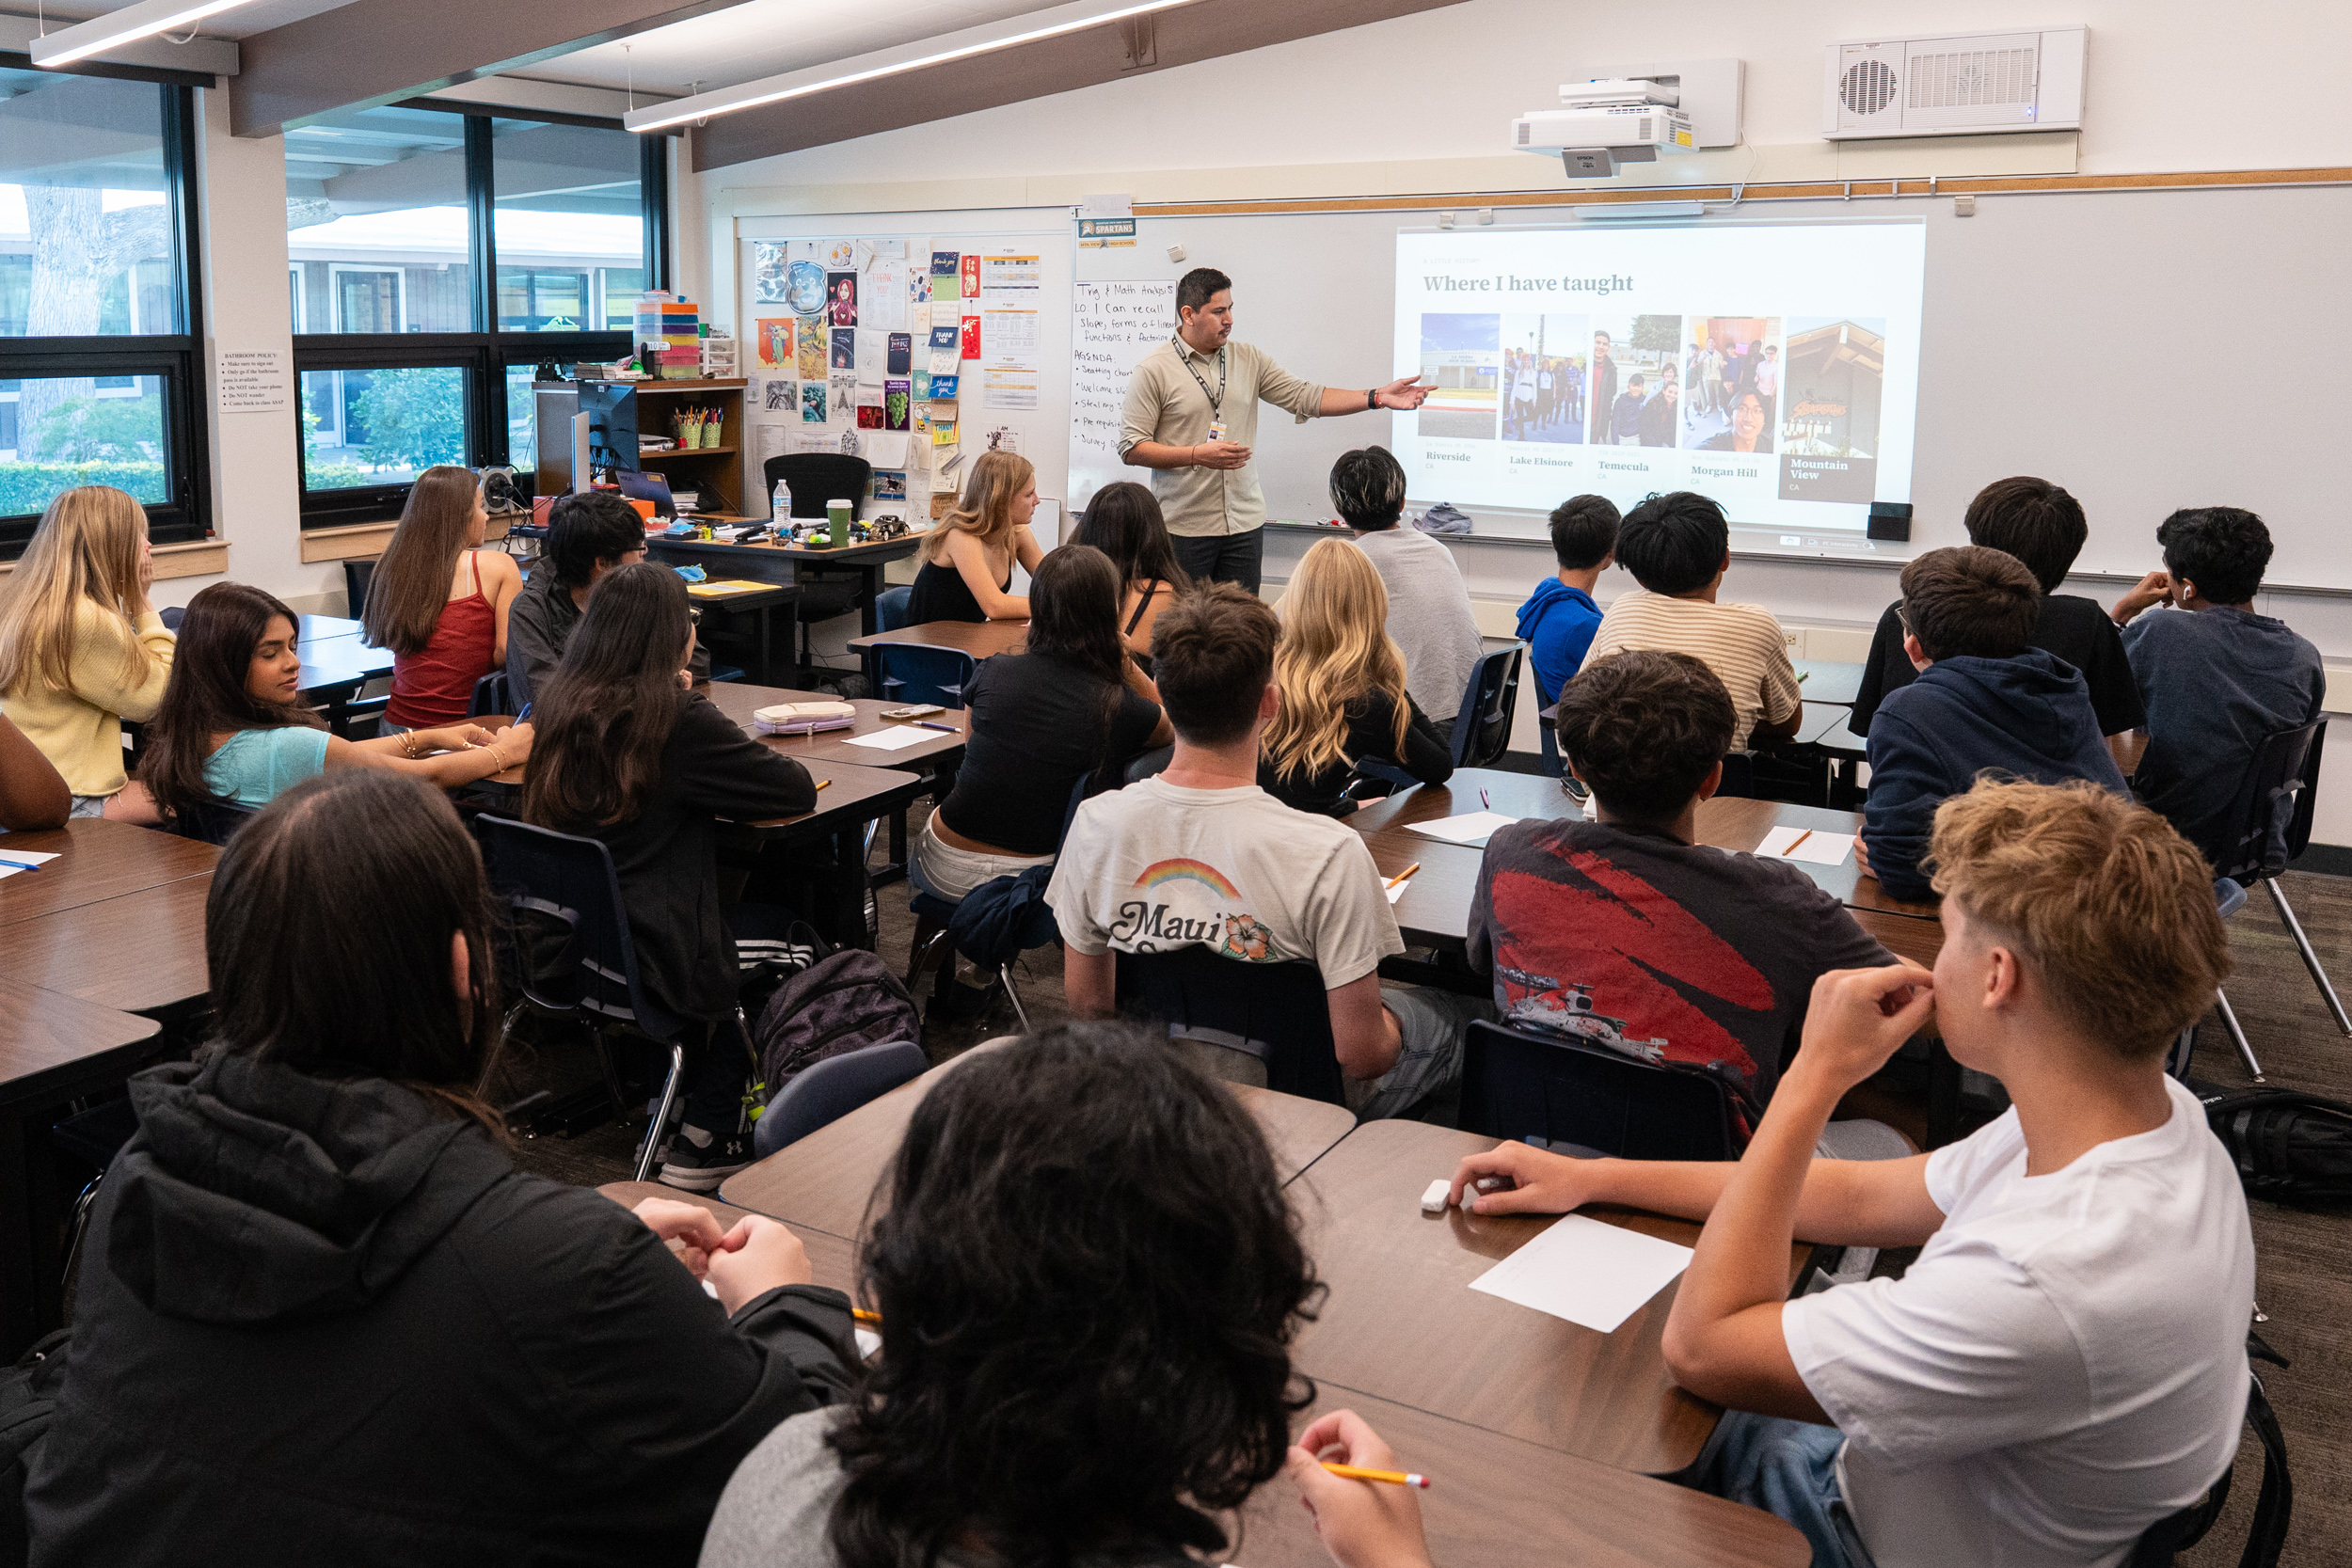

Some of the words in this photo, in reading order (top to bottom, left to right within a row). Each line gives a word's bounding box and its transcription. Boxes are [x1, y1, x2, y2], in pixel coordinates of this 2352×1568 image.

[1095, 224, 1134, 234] SPARTANS
[1423, 275, 1490, 292] Where
[1495, 276, 1503, 291] I
[1508, 275, 1557, 292] have
[1562, 274, 1634, 296] taught
[1077, 284, 1100, 300] Trig
[1114, 284, 1136, 295] Math
[1142, 285, 1173, 296] Analysis
[1133, 304, 1164, 314] recall
[1111, 319, 1136, 329] forms
[1142, 320, 1155, 328] of
[1085, 330, 1121, 341] functions
[1074, 350, 1116, 363] AGENDA:
[936, 377, 954, 387] thank
[1081, 382, 1112, 394] Welcome
[1081, 400, 1100, 408] Steal
[1103, 403, 1114, 412] my
[1096, 419, 1120, 429] requisit
[1081, 434, 1105, 451] Survey
[1426, 451, 1471, 462] Riverside
[1510, 456, 1533, 465] Lake
[1534, 457, 1574, 467] Elsinore
[1597, 461, 1649, 471] Temecula
[1790, 458, 1849, 470] Mountain
[1692, 466, 1734, 478] Morgan
[1737, 468, 1757, 478] Hill
[1790, 469, 1820, 480] View
[1109, 901, 1221, 942] Maui
